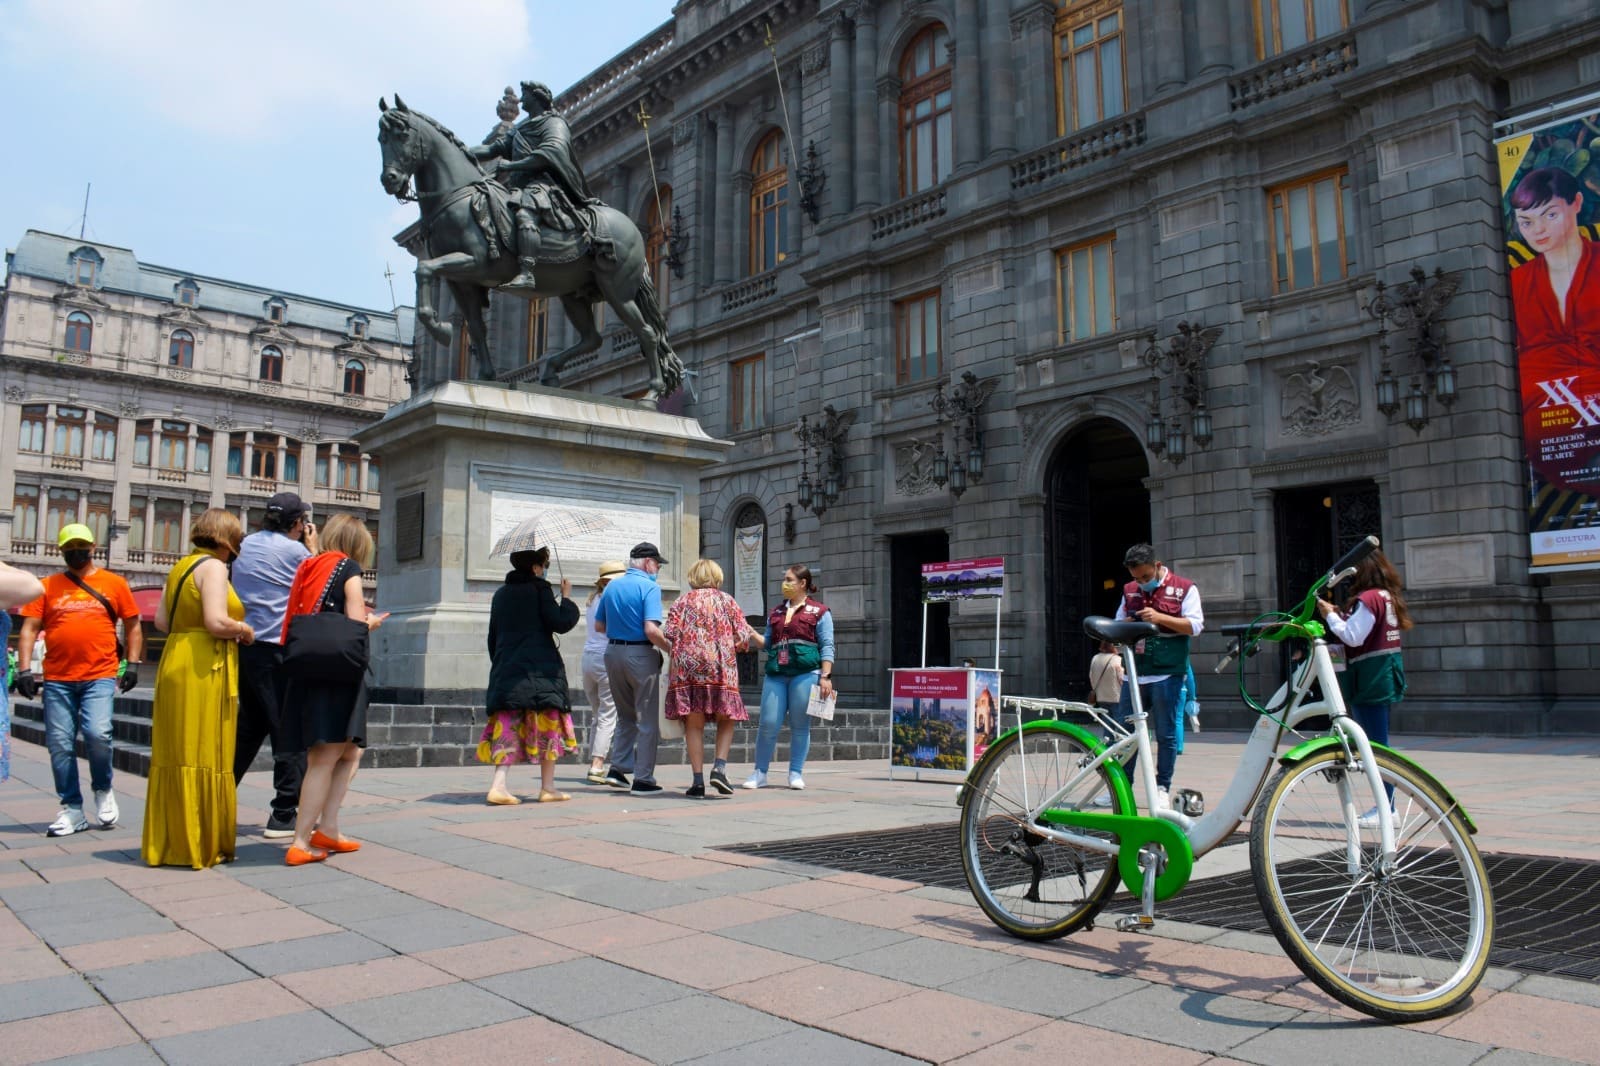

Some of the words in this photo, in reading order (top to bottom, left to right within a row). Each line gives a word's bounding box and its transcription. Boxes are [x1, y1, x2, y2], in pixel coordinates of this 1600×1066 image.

[1504, 146, 1520, 157] 40
[1536, 376, 1580, 409] XX
[1541, 408, 1570, 419] DIEGO
[1541, 416, 1576, 428] RIVERA
[1540, 433, 1585, 445] COLECCIÓN
[1541, 445, 1557, 454] DEL
[1558, 441, 1586, 451] MUSEO
[1554, 451, 1575, 460] ARTE
[1560, 468, 1589, 477] PRIMER
[1555, 534, 1596, 544] CULTURA
